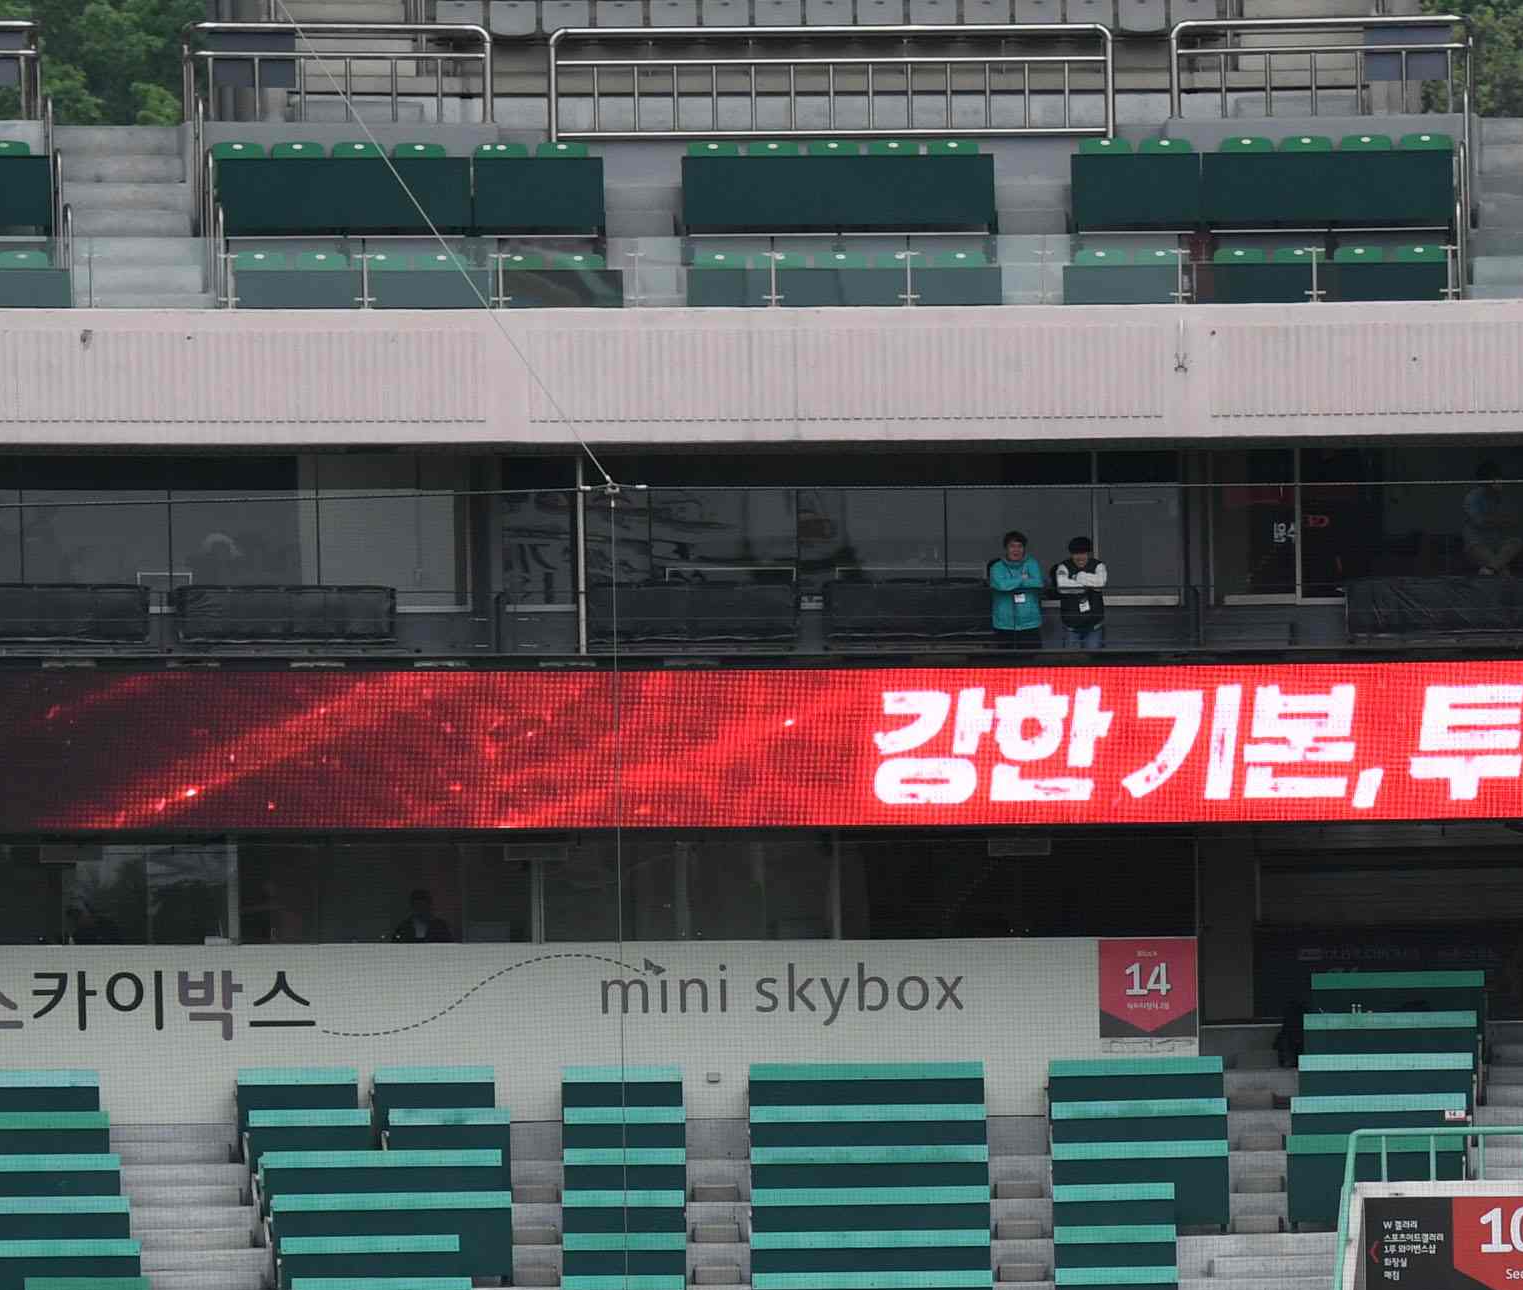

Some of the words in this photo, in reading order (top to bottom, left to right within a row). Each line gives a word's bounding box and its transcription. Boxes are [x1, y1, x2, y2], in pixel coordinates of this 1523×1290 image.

[873, 683, 1115, 806] 강한
[1123, 683, 1382, 810] 기본,
[600, 964, 729, 1015] mini
[754, 963, 966, 1027] skybox
[1125, 962, 1172, 996] 14
[1383, 1221, 1393, 1230] W
